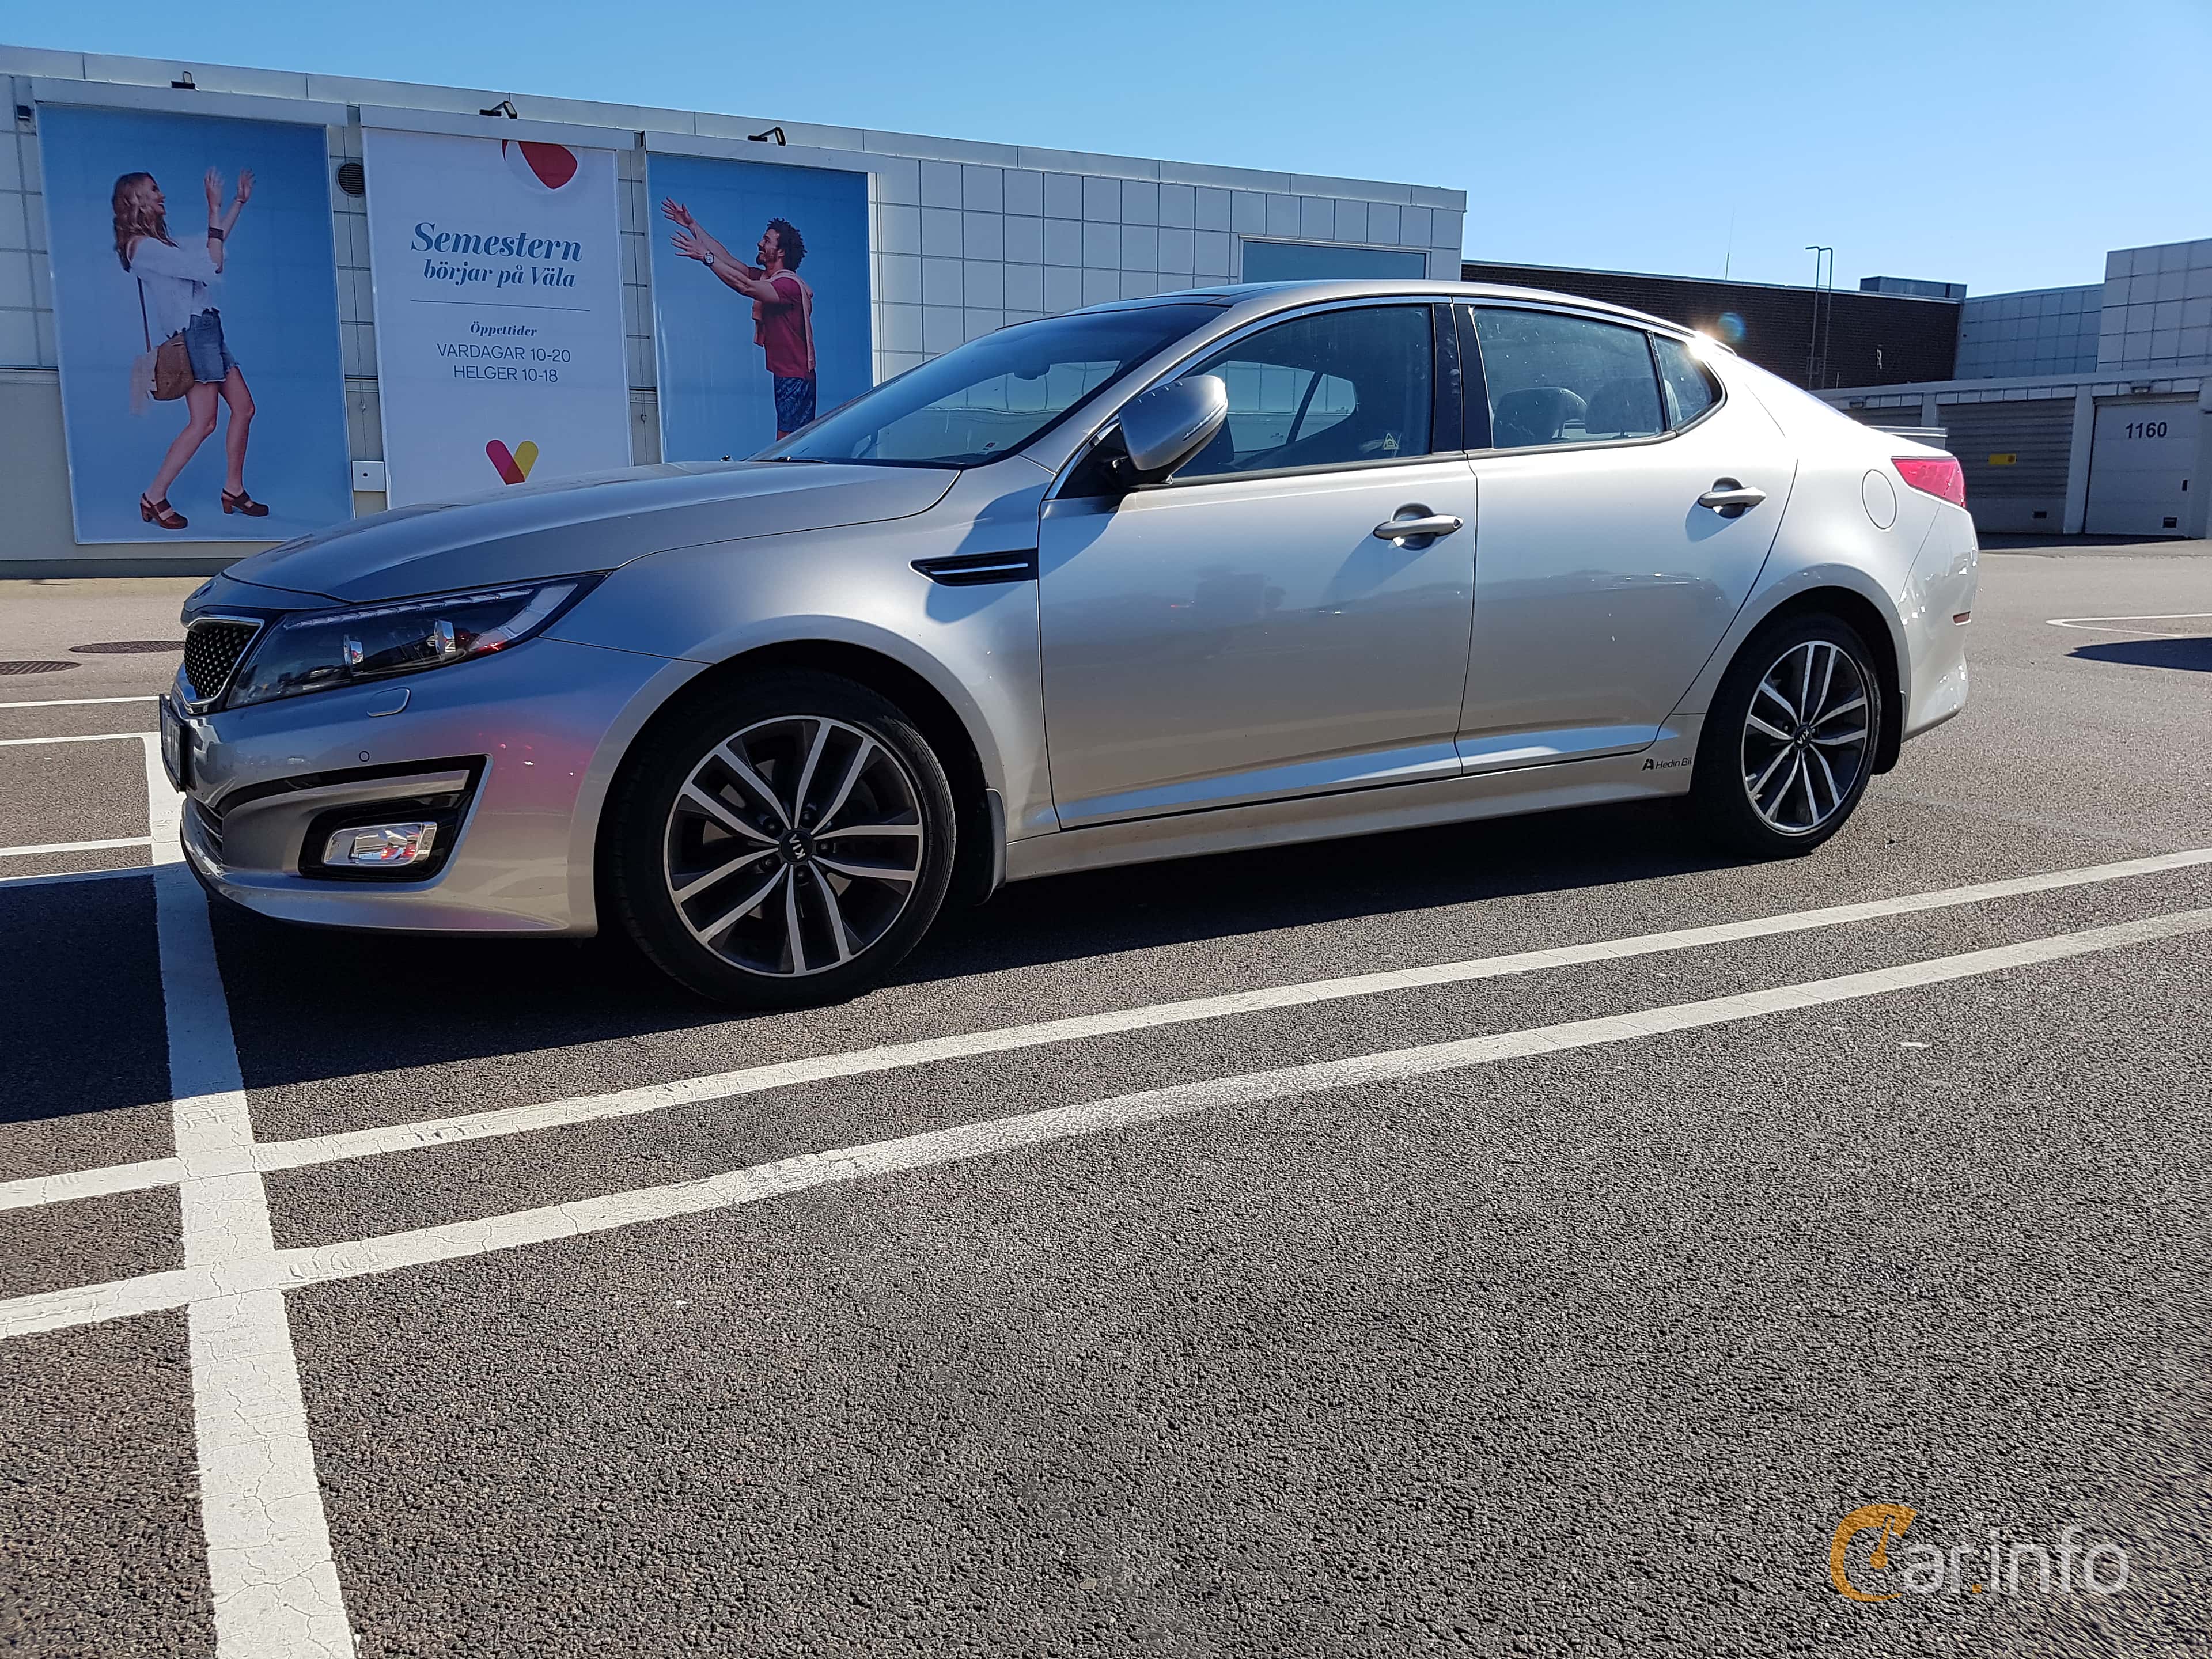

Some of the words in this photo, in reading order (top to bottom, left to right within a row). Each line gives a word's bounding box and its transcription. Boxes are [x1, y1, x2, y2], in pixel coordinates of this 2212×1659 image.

[411, 222, 582, 262] Semestern
[423, 259, 493, 286] börjar
[496, 264, 524, 289] på
[531, 267, 576, 287] Väla
[470, 321, 537, 336] Öppettider
[437, 343, 525, 360] VARDAGAR
[531, 348, 571, 363] 10-20
[454, 365, 517, 380] HELGER
[522, 368, 558, 382] 10-18
[2126, 422, 2168, 438] 1160
[1655, 760, 1680, 769] Hedin
[1681, 757, 1692, 766] Bil
